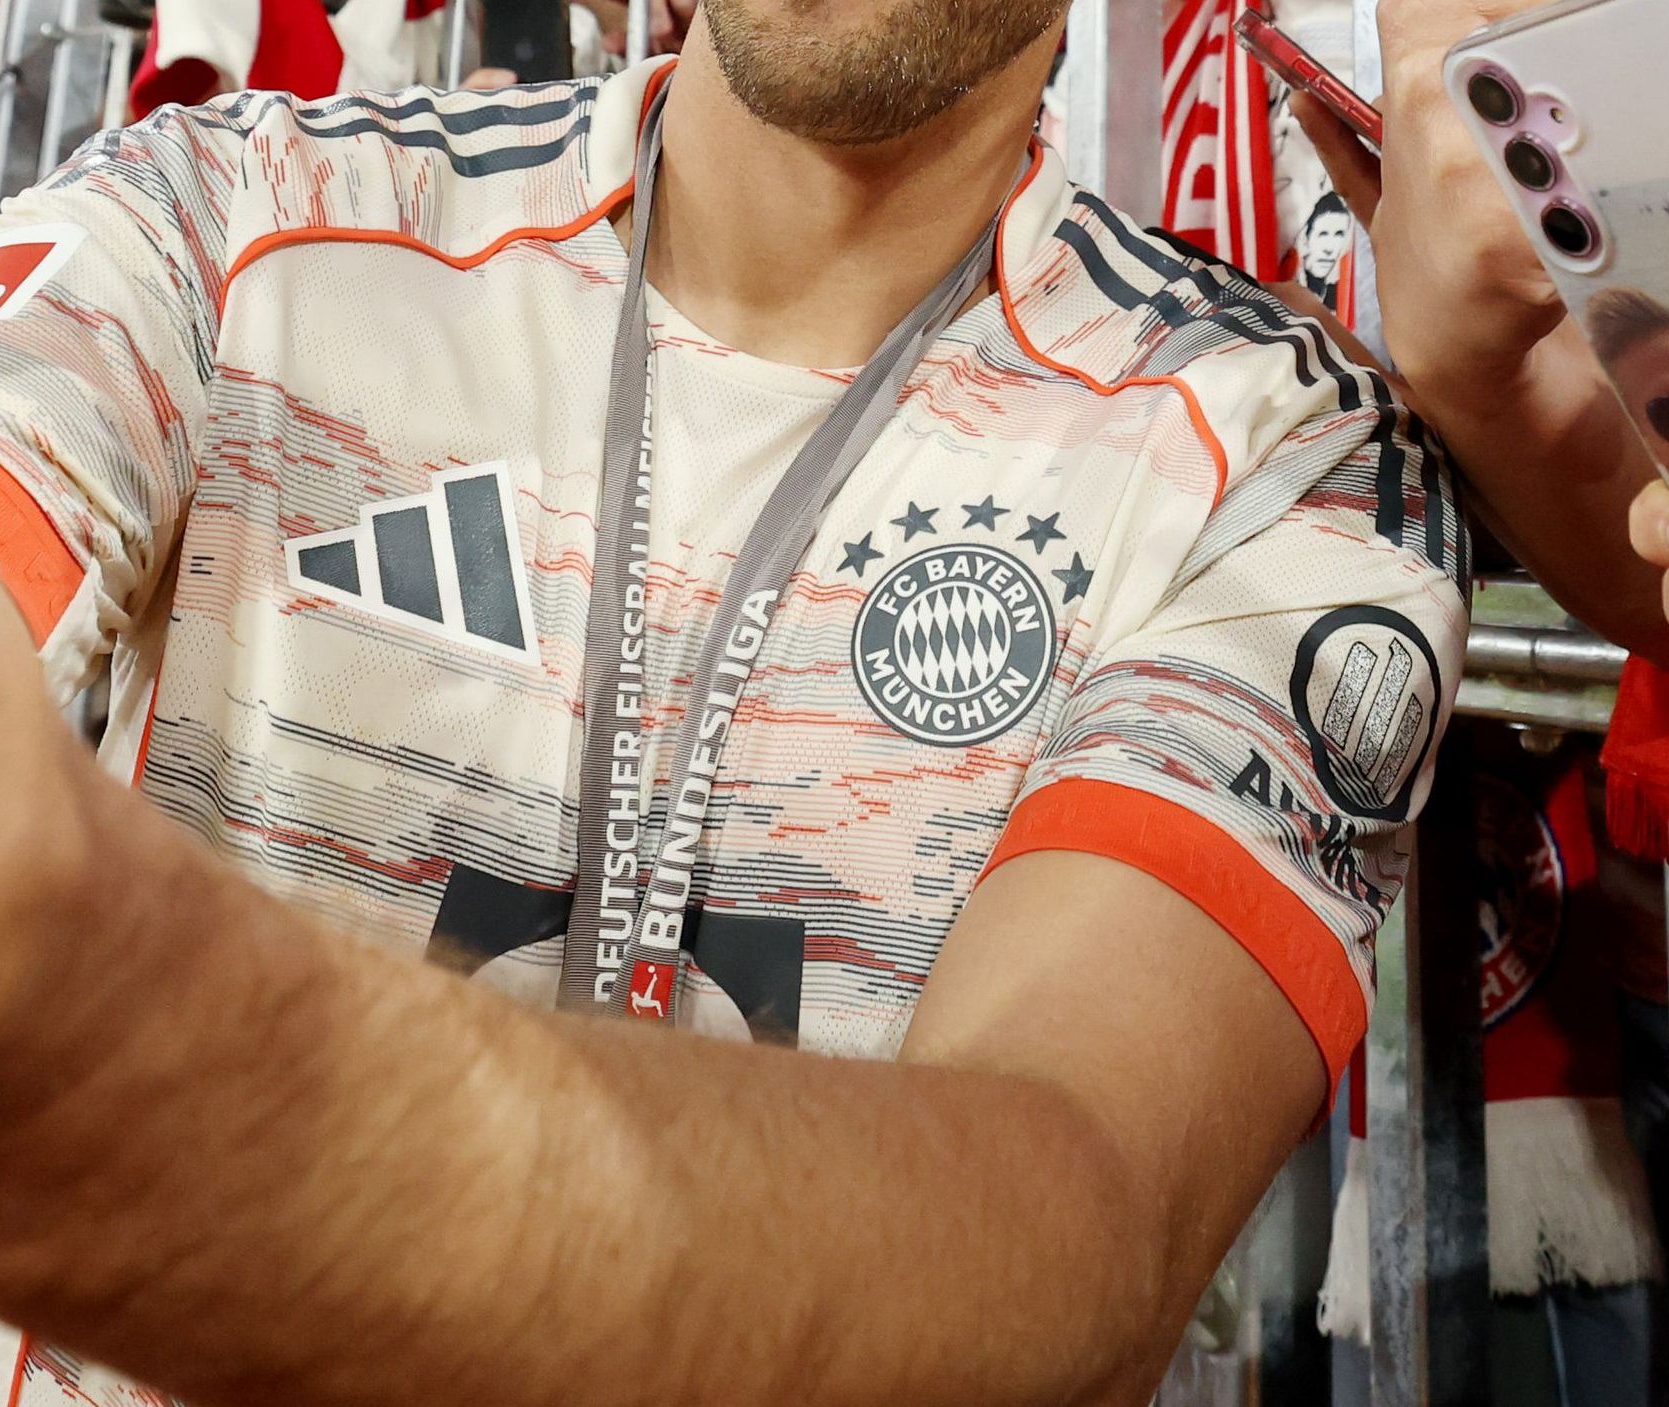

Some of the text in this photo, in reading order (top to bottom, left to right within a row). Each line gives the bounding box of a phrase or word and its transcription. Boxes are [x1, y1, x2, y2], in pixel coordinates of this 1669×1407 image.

[875, 554, 1041, 634] FC BAYERN
[639, 589, 779, 950] BUNDESLIGA
[865, 647, 1031, 732] MÜNCHEN
[594, 730, 641, 1003] DEUTSCHER
